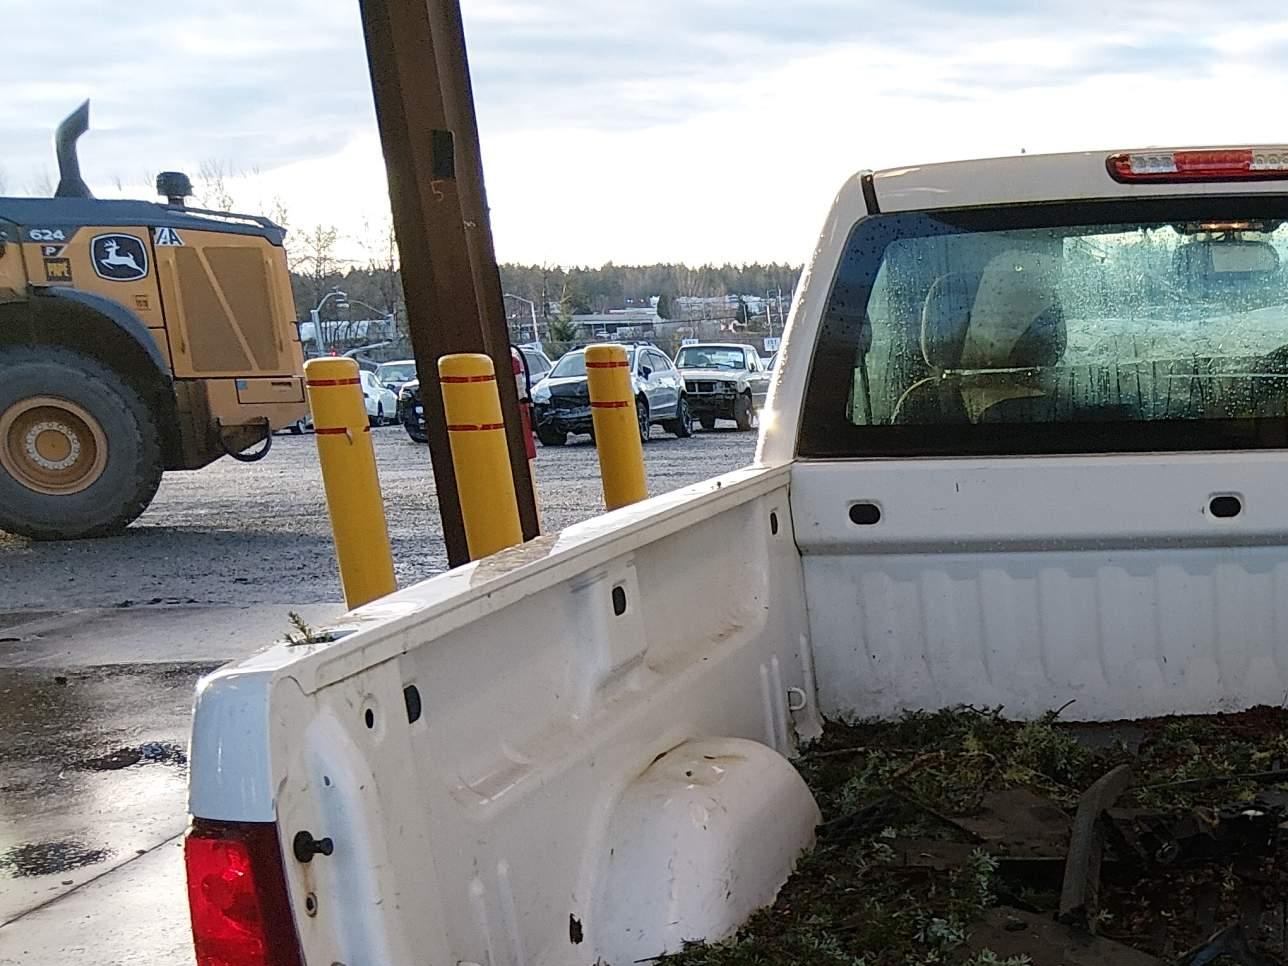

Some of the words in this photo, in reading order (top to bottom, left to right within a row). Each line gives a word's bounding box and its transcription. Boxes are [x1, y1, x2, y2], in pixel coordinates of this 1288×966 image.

[430, 180, 444, 202] 5
[29, 229, 65, 241] 624
[45, 246, 57, 256] P
